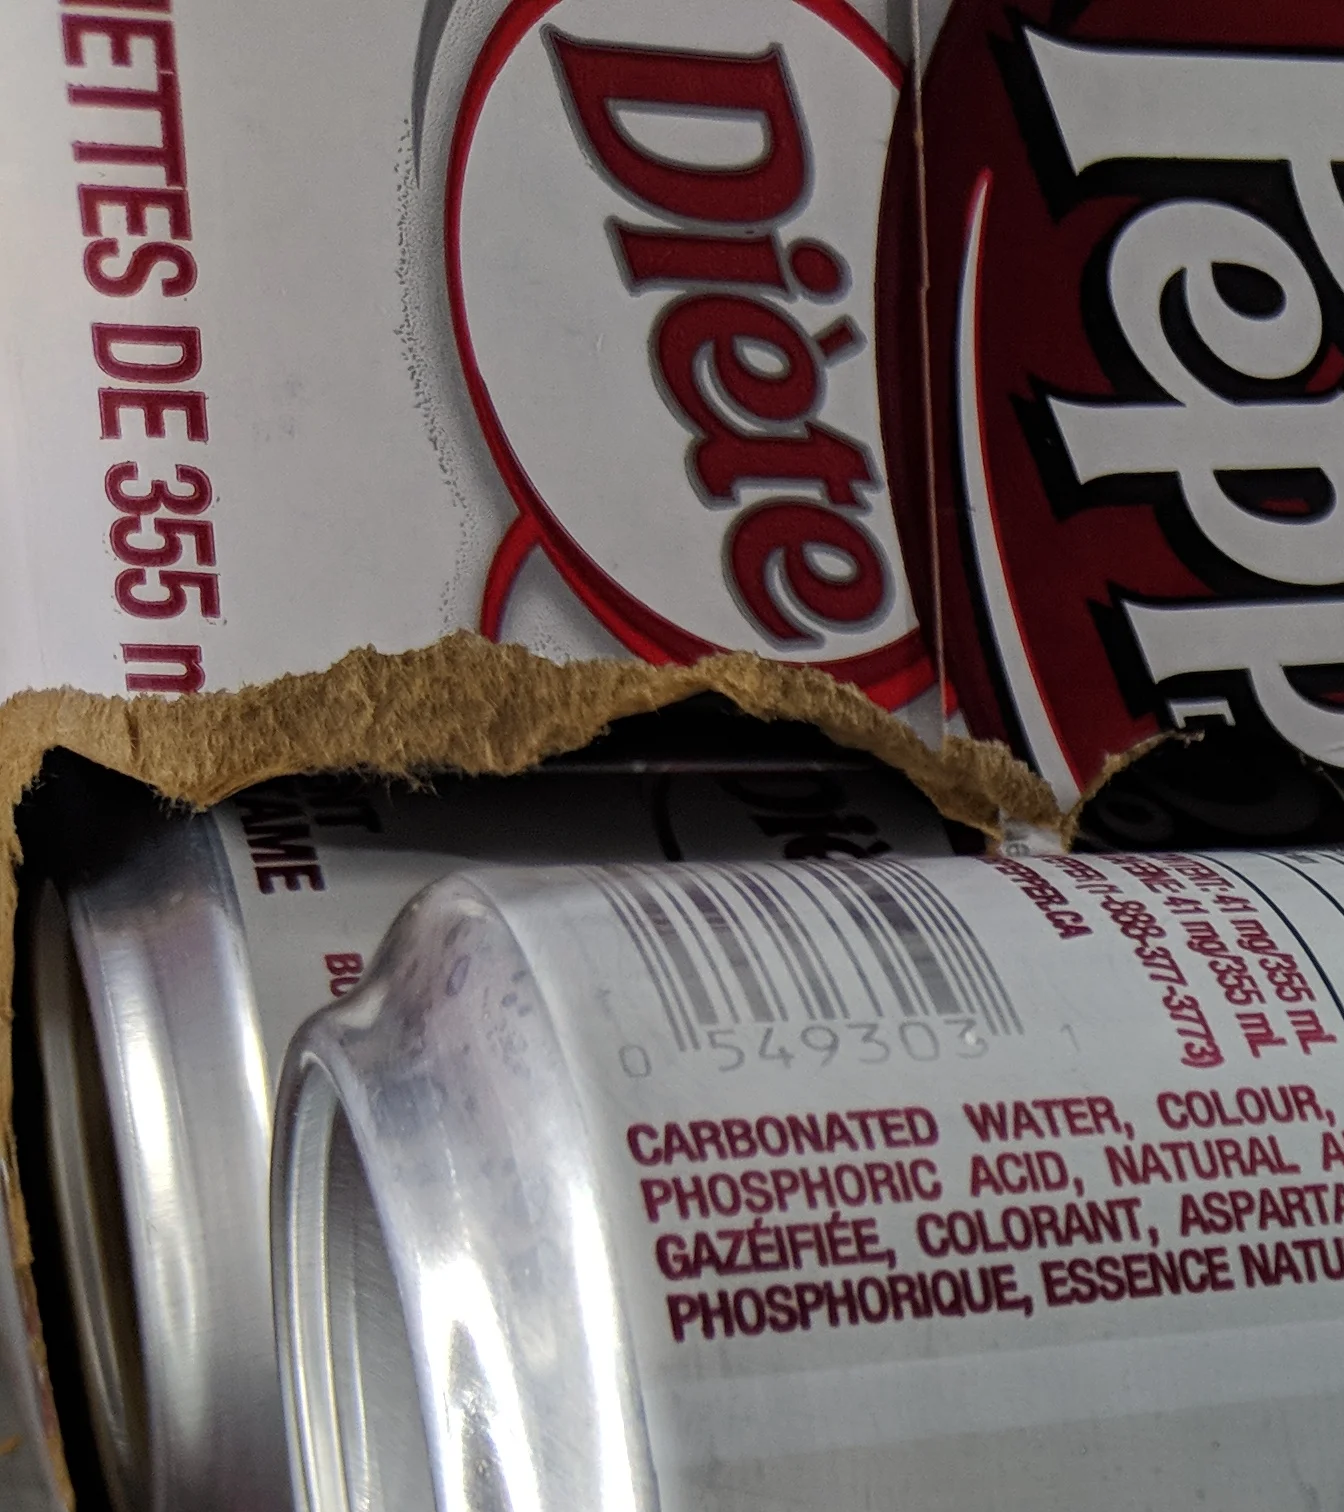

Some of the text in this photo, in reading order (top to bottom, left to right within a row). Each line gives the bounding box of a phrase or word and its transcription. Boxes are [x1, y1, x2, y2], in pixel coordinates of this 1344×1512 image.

[59, 0, 198, 298] ETTES
[91, 322, 209, 443] DE
[541, 23, 898, 652] Diète
[104, 462, 222, 620] 355
[626, 1105, 940, 1167] CARBONATED
[961, 1095, 1136, 1143] WATER,
[1155, 1083, 1337, 1132] COLOUR,
[639, 1157, 944, 1224] PHOSPHORIC
[969, 1150, 1086, 1198] ACID,
[1104, 1134, 1301, 1188] NATURAL
[654, 1210, 898, 1282] GAZÉIFIÉE,
[914, 1197, 1160, 1259] COLORANT,
[665, 1263, 1035, 1345] PHOSPHORIQUE,
[1040, 1245, 1237, 1307] ESSENCE
